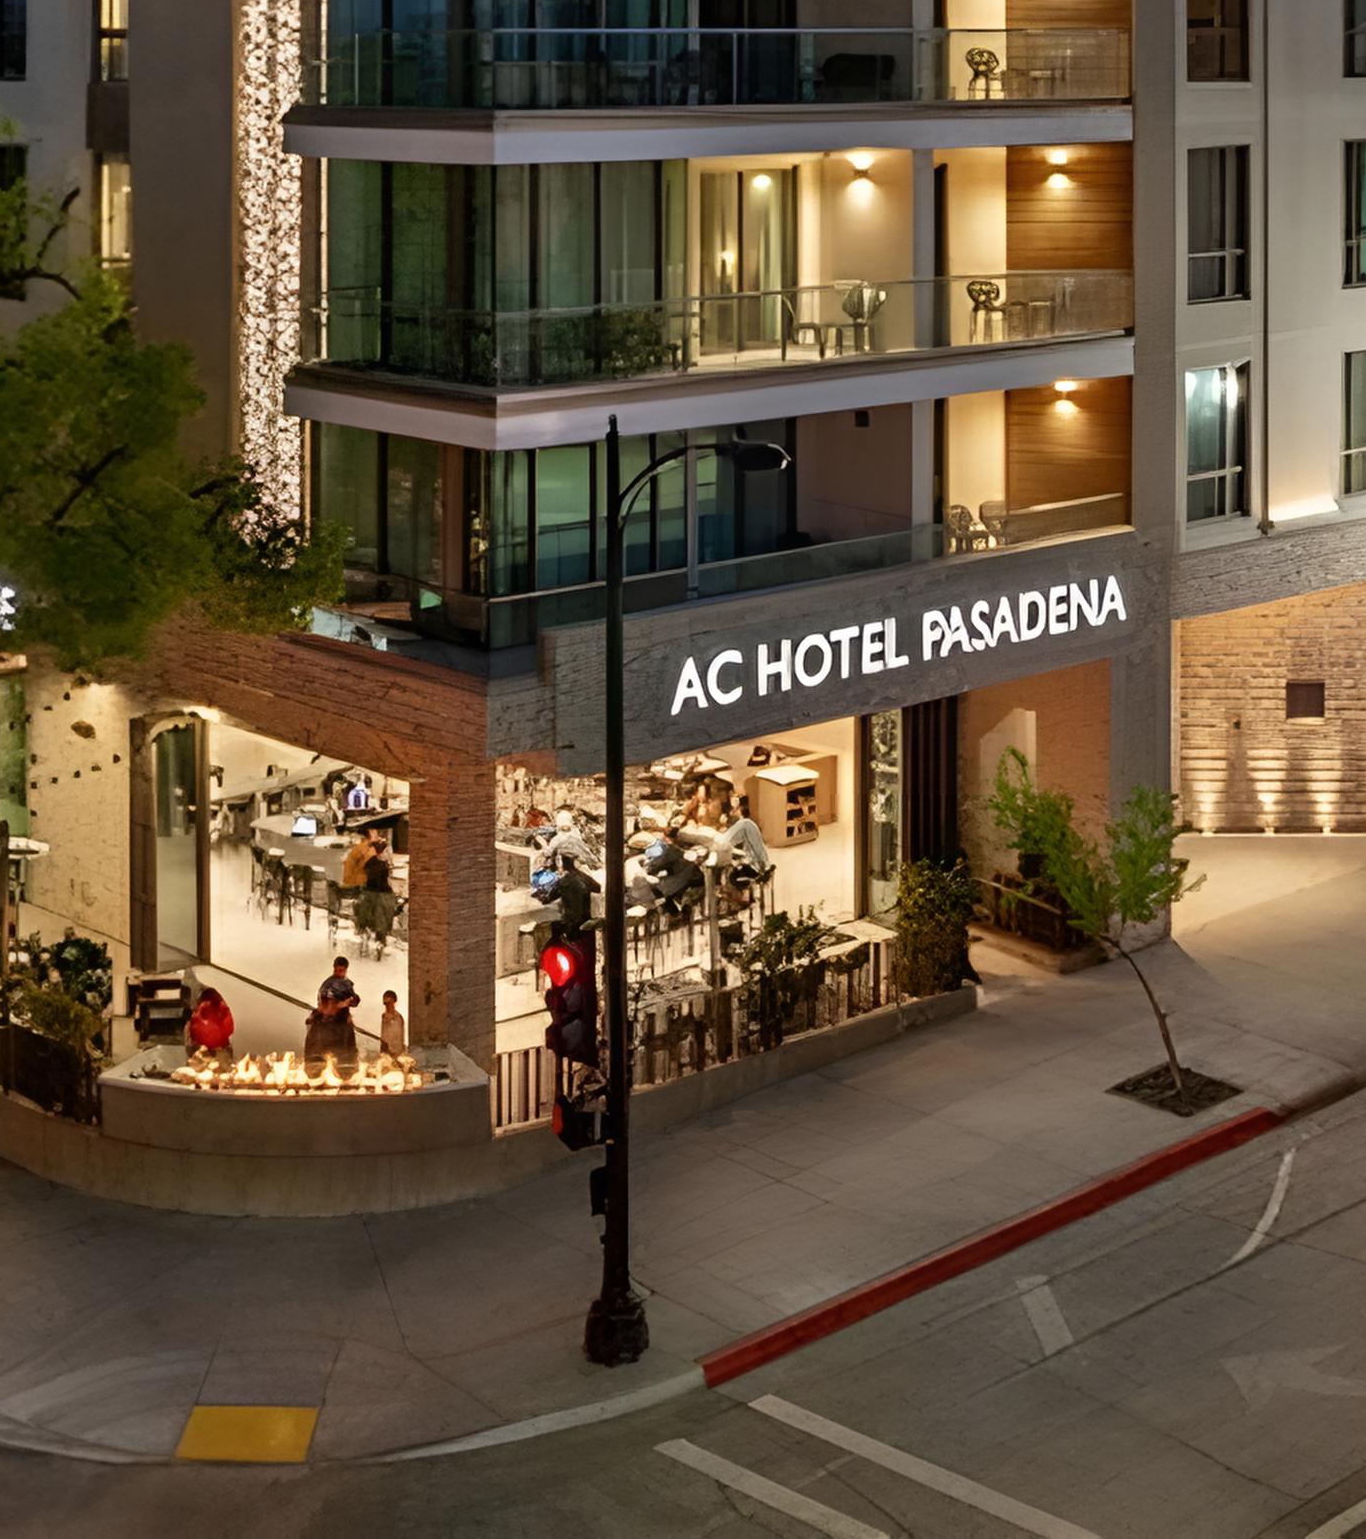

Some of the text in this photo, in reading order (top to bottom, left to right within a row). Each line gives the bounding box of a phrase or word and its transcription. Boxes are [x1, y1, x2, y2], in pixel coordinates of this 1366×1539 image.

[670, 575, 1128, 716] AC HOTEL PASADENA
